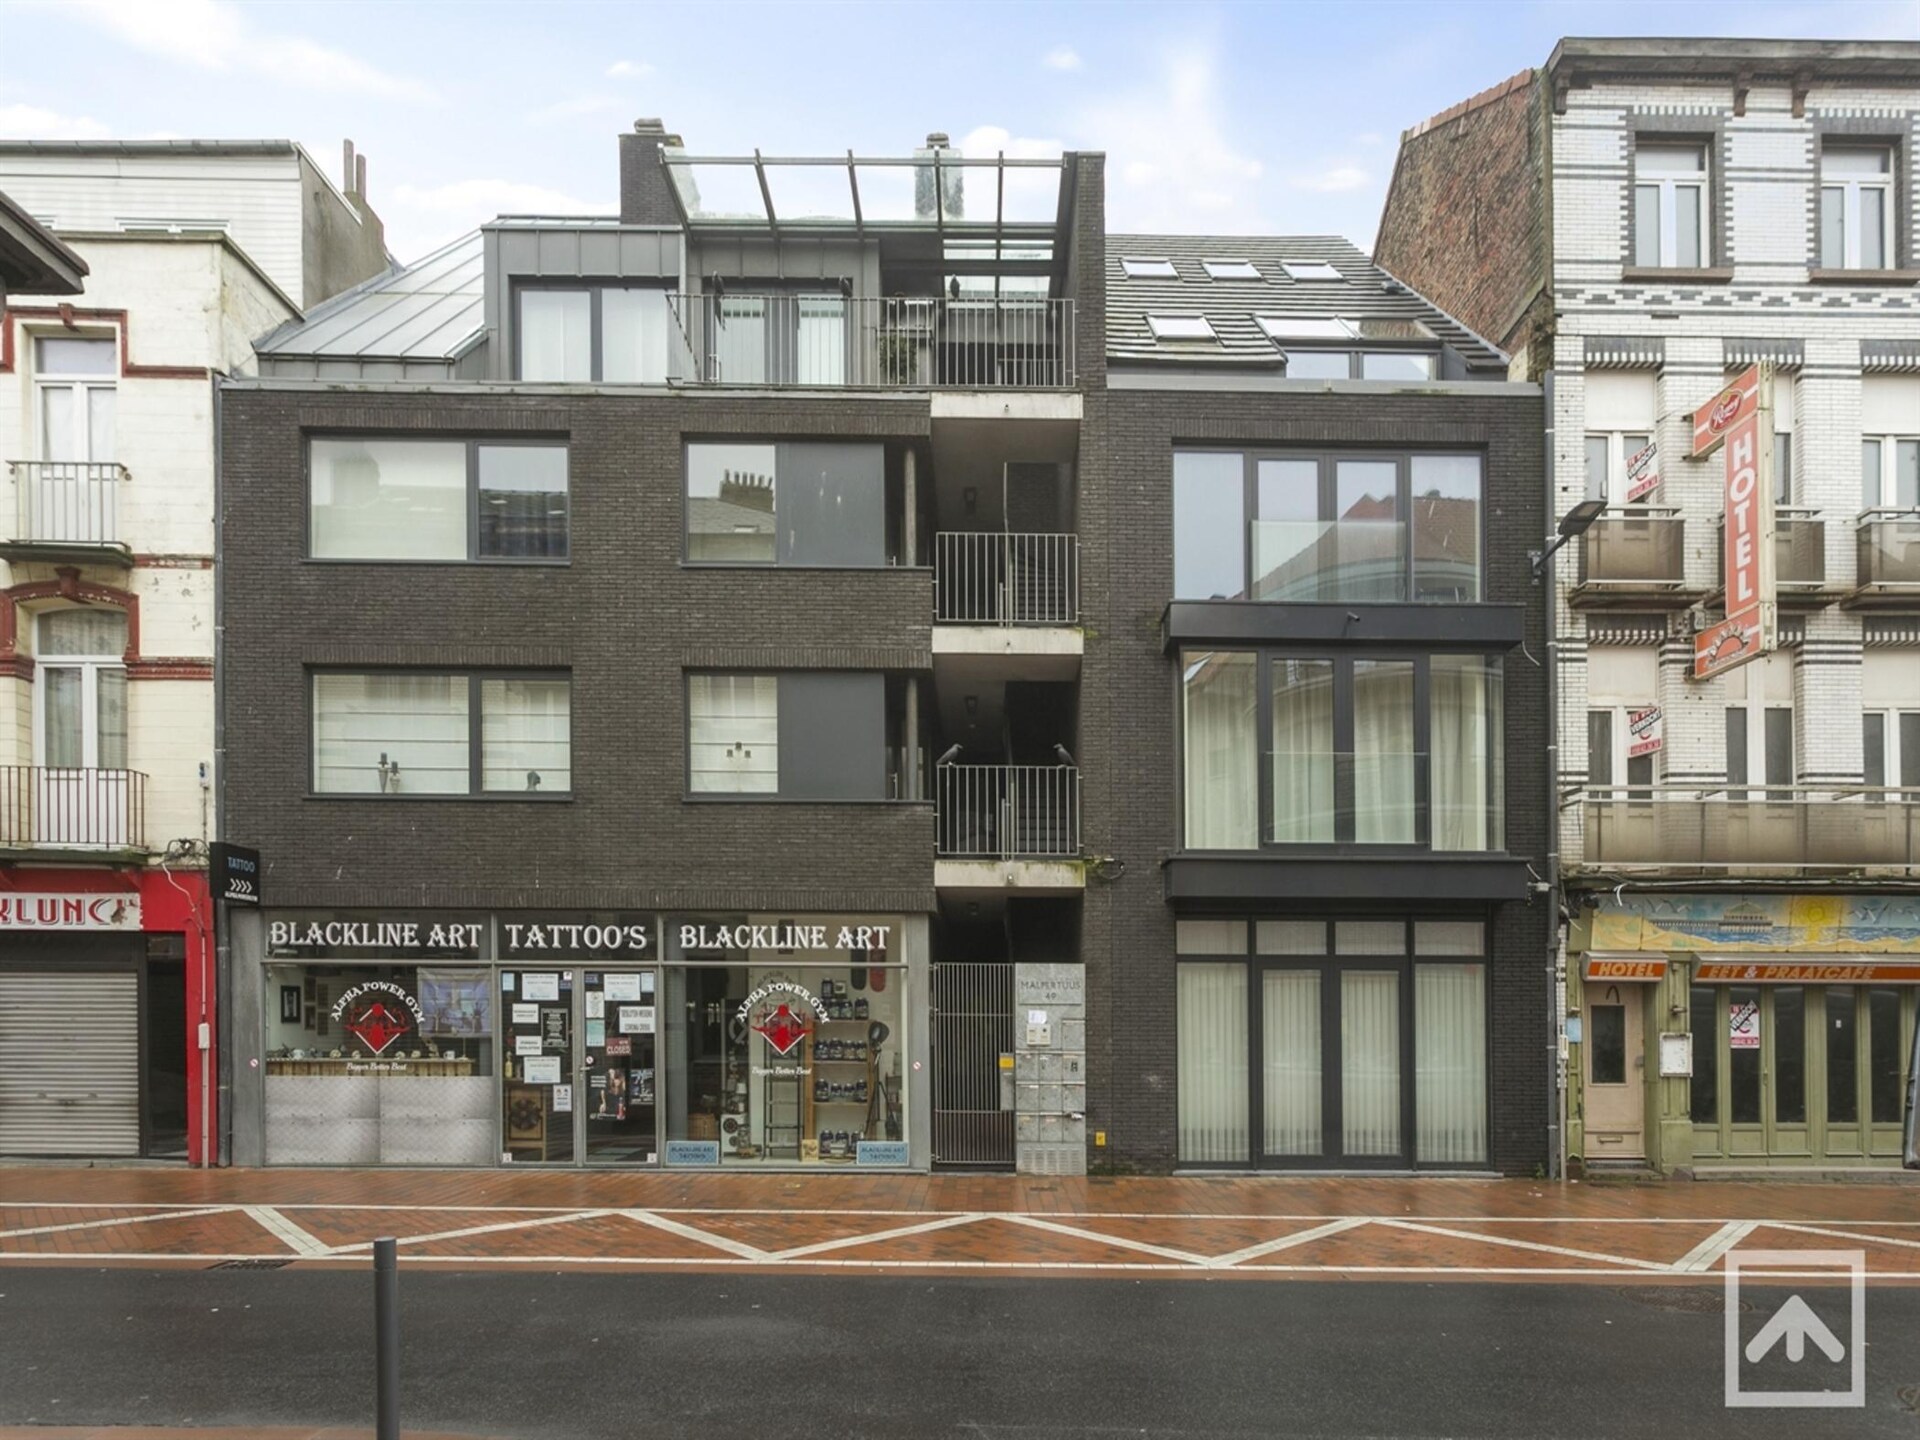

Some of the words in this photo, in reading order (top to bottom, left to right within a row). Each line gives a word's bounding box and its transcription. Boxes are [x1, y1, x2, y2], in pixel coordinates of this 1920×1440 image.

[1729, 431, 1756, 603] HOTEL
[227, 856, 256, 873] TATTOO
[0, 898, 137, 925] KLUNC
[270, 921, 421, 947] BLACKLINE
[426, 923, 483, 949] ART
[504, 924, 647, 949] TATTOO'S
[679, 924, 829, 949] BLACKLINE
[835, 925, 890, 950] ART
[1598, 962, 1655, 977] HOTEL
[1708, 966, 1743, 978] EET
[1744, 966, 1758, 978] &
[330, 986, 363, 1022] ALPHA
[362, 981, 406, 1001] POWER
[405, 996, 425, 1024] GYM
[735, 988, 768, 1023] ALPHA
[767, 982, 811, 1001] POWER
[810, 996, 831, 1024] GYM
